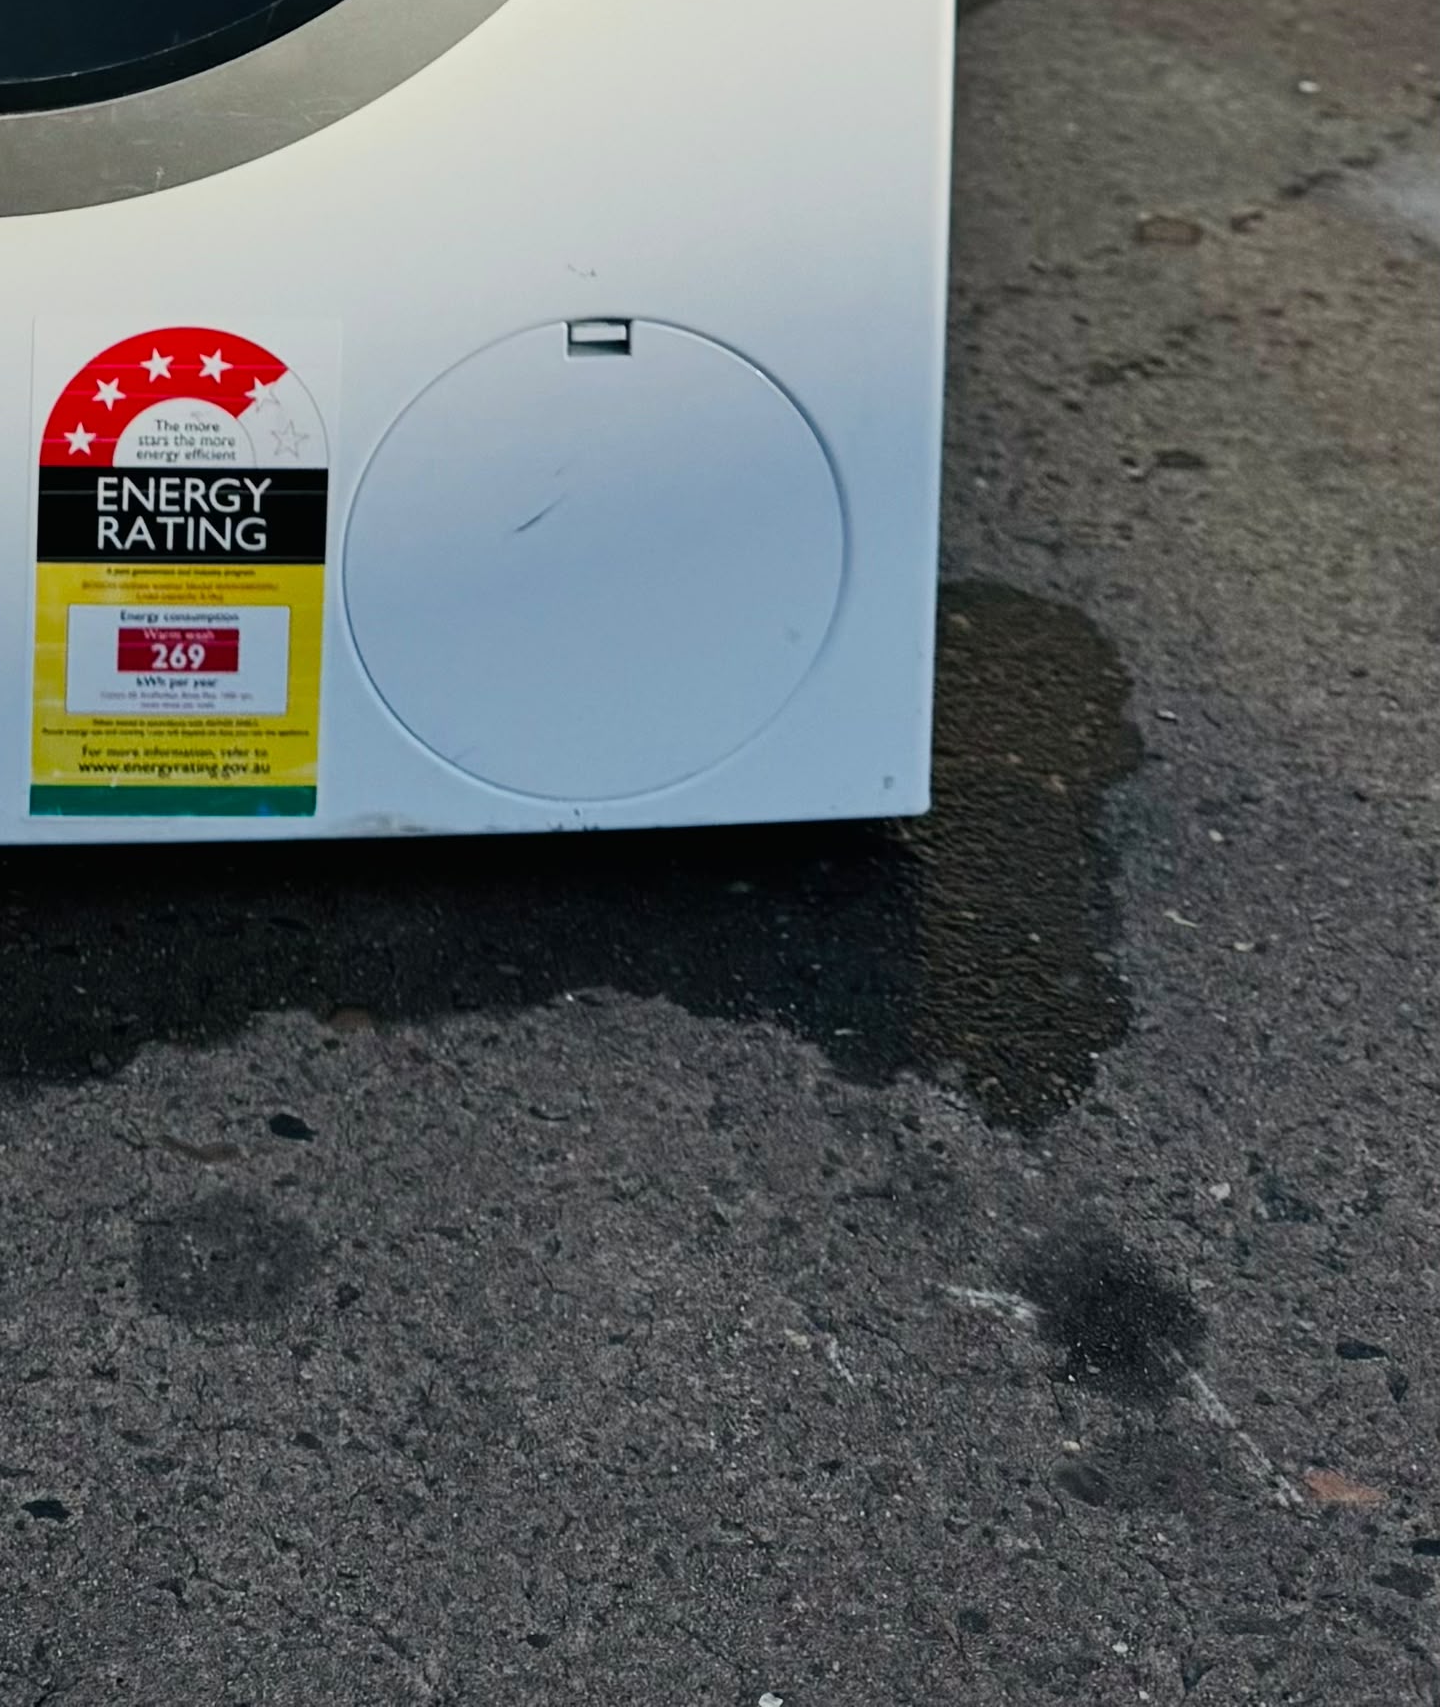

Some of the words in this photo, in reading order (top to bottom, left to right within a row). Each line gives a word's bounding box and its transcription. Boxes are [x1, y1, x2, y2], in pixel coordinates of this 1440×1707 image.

[155, 420, 180, 432] The
[185, 422, 219, 433] more
[139, 435, 169, 447] stars
[175, 435, 195, 447] the
[200, 437, 235, 447] more
[136, 451, 180, 463] energy
[185, 449, 236, 461] efficient
[97, 477, 272, 513] ENERGY
[98, 516, 266, 550] RATING
[120, 610, 158, 623] Energy
[152, 645, 205, 670] 269
